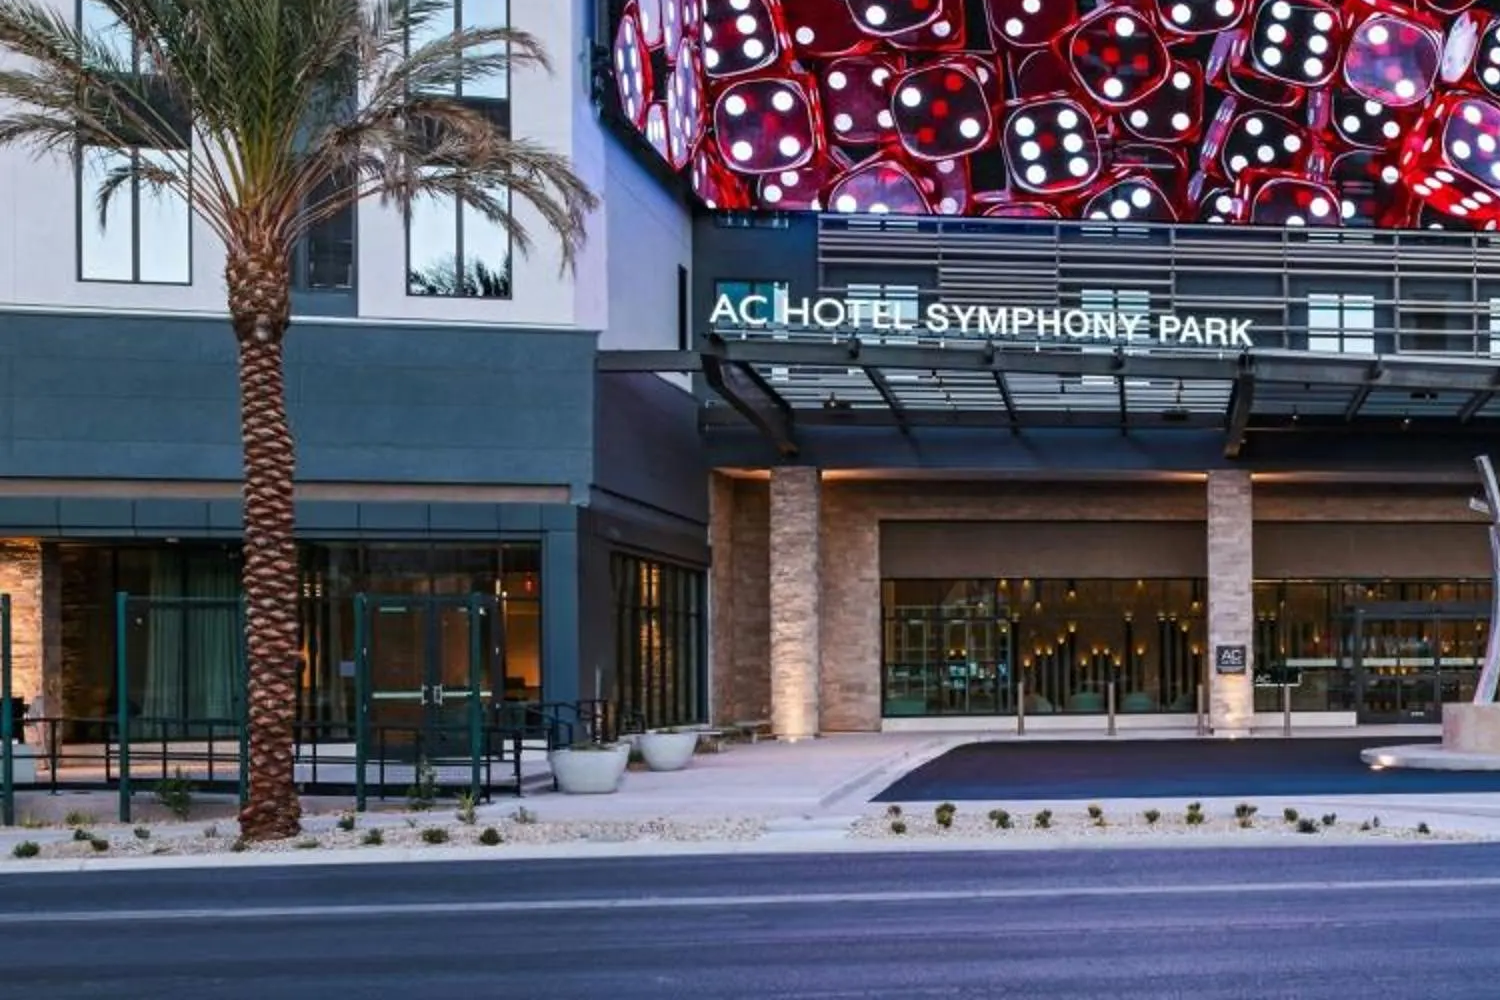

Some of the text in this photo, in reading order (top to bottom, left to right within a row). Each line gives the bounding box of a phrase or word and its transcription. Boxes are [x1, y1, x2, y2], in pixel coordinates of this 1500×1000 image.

[709, 293, 1254, 347] AC HOTEL SYMPHONY PARK
[1221, 649, 1242, 660] AC
